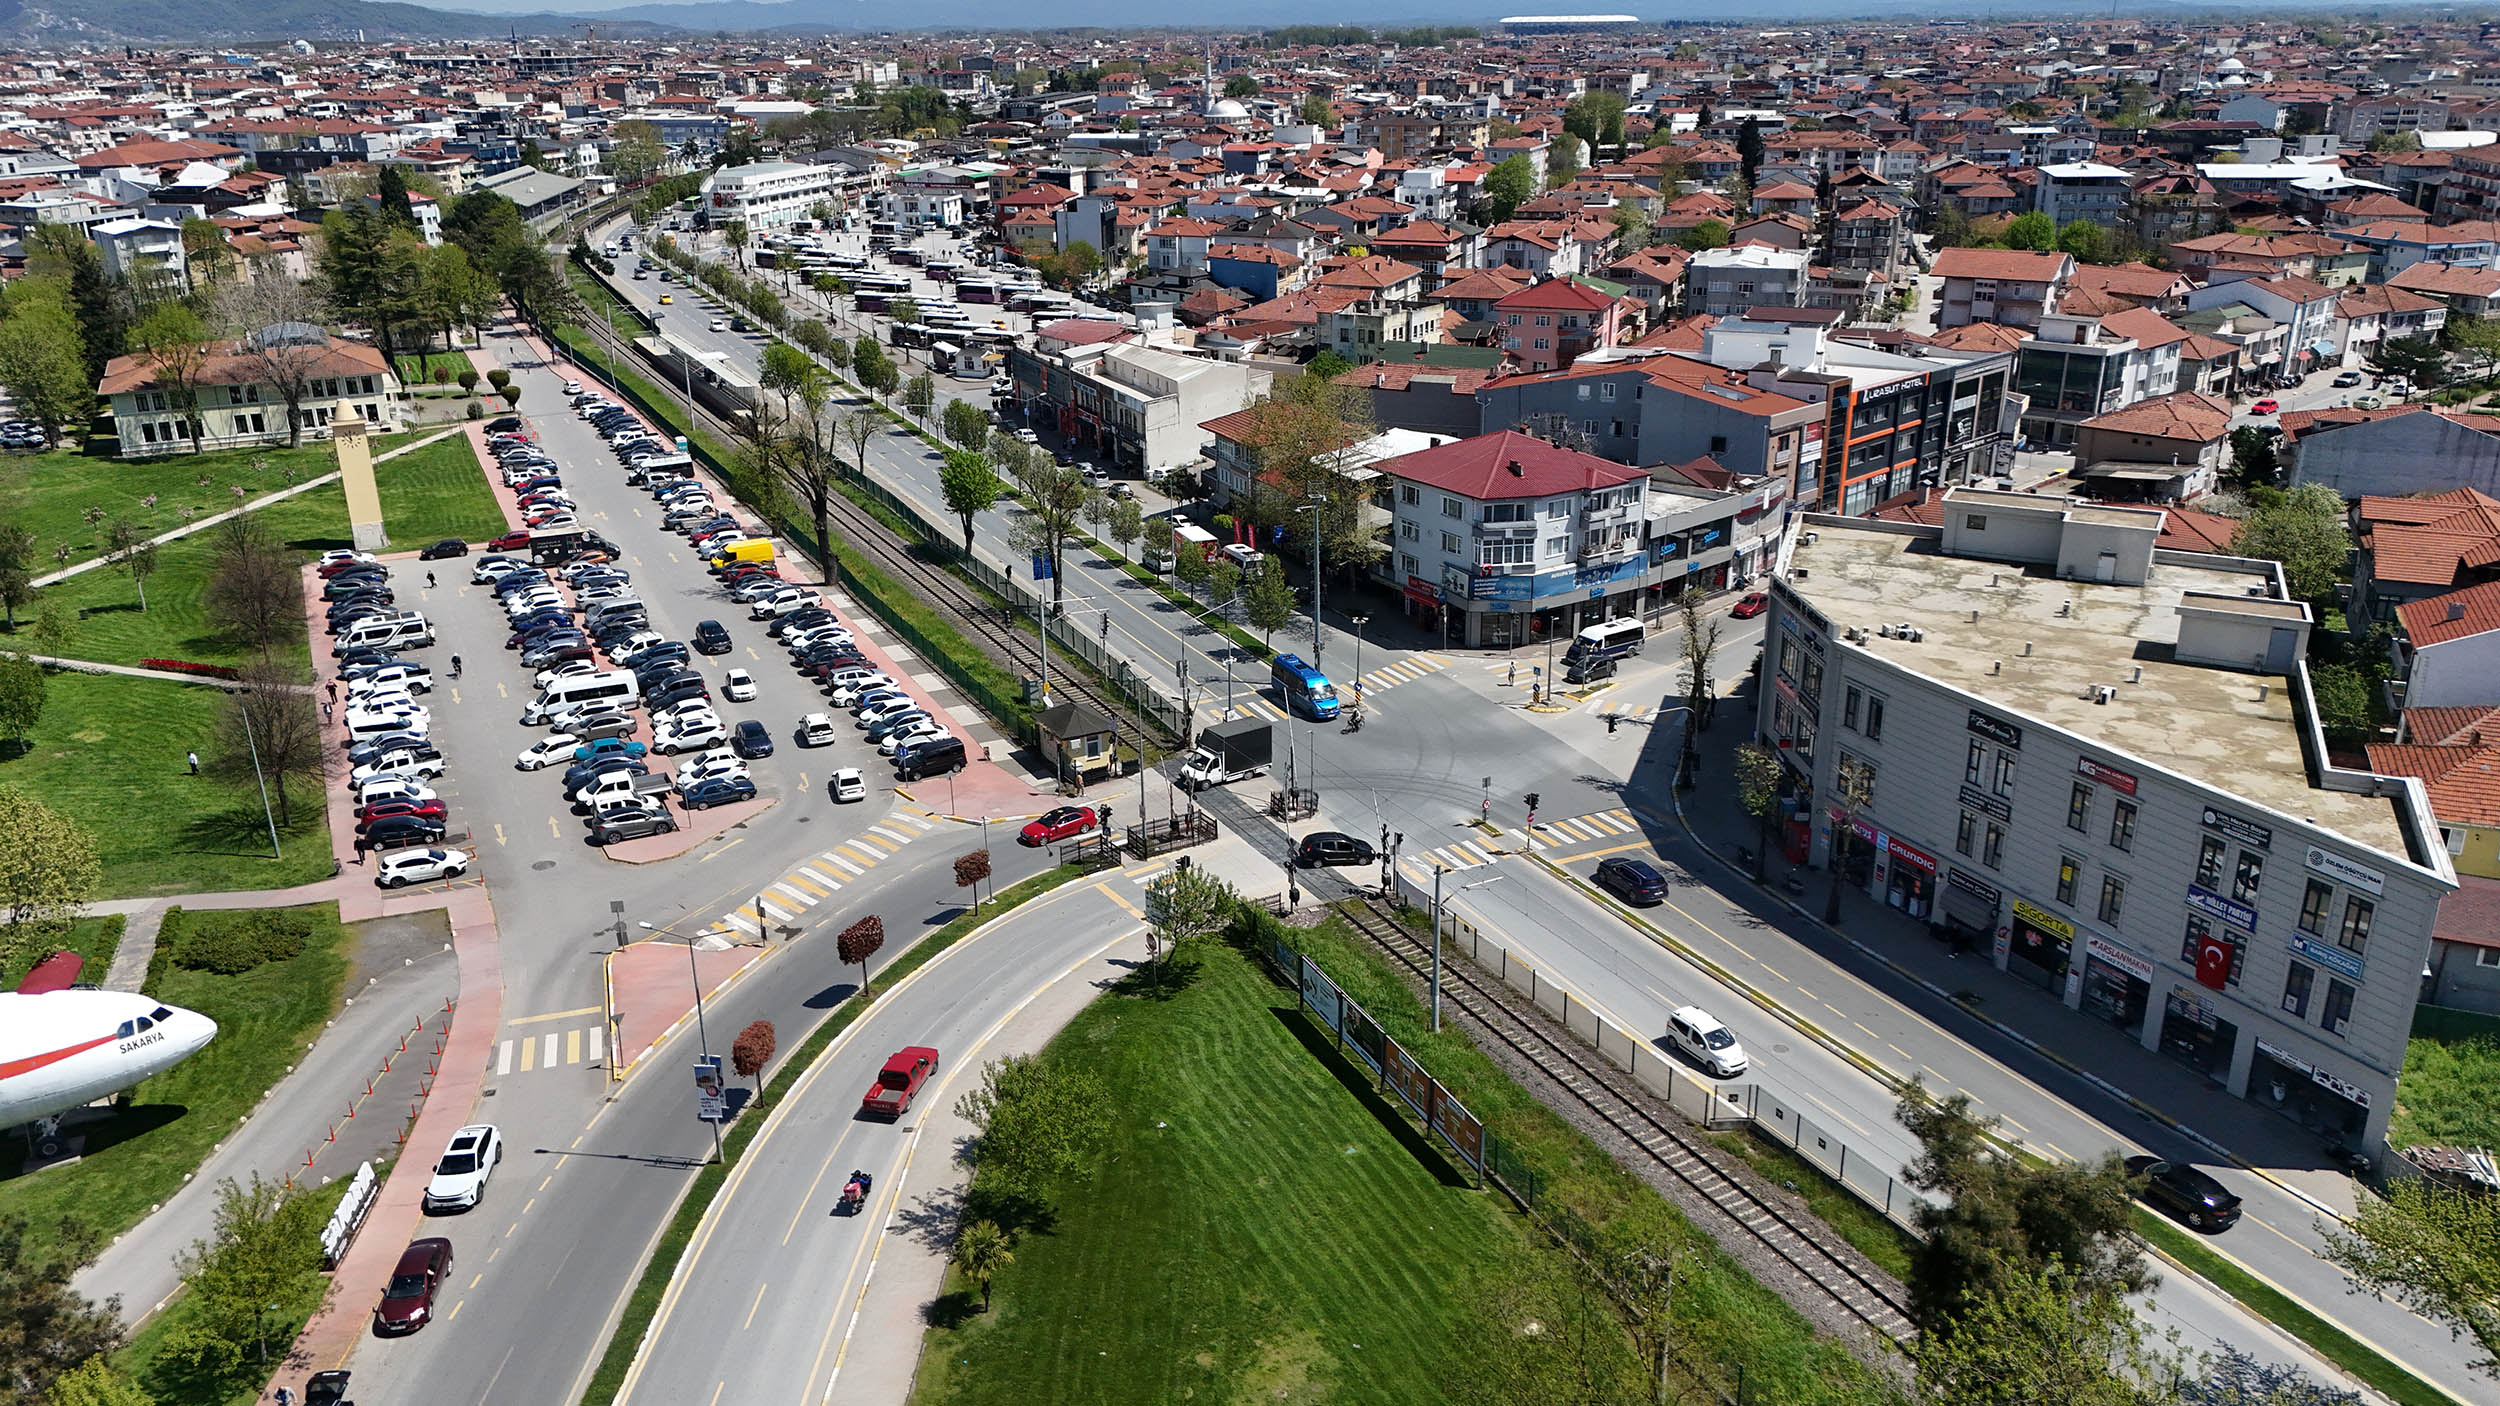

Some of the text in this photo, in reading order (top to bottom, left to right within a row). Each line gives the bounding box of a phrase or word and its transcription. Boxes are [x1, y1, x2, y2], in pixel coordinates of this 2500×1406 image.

[1901, 378, 1923, 390] HOTEL
[1889, 842, 1935, 871] GRUNDIG
[119, 1031, 165, 1055] SAKARYA
